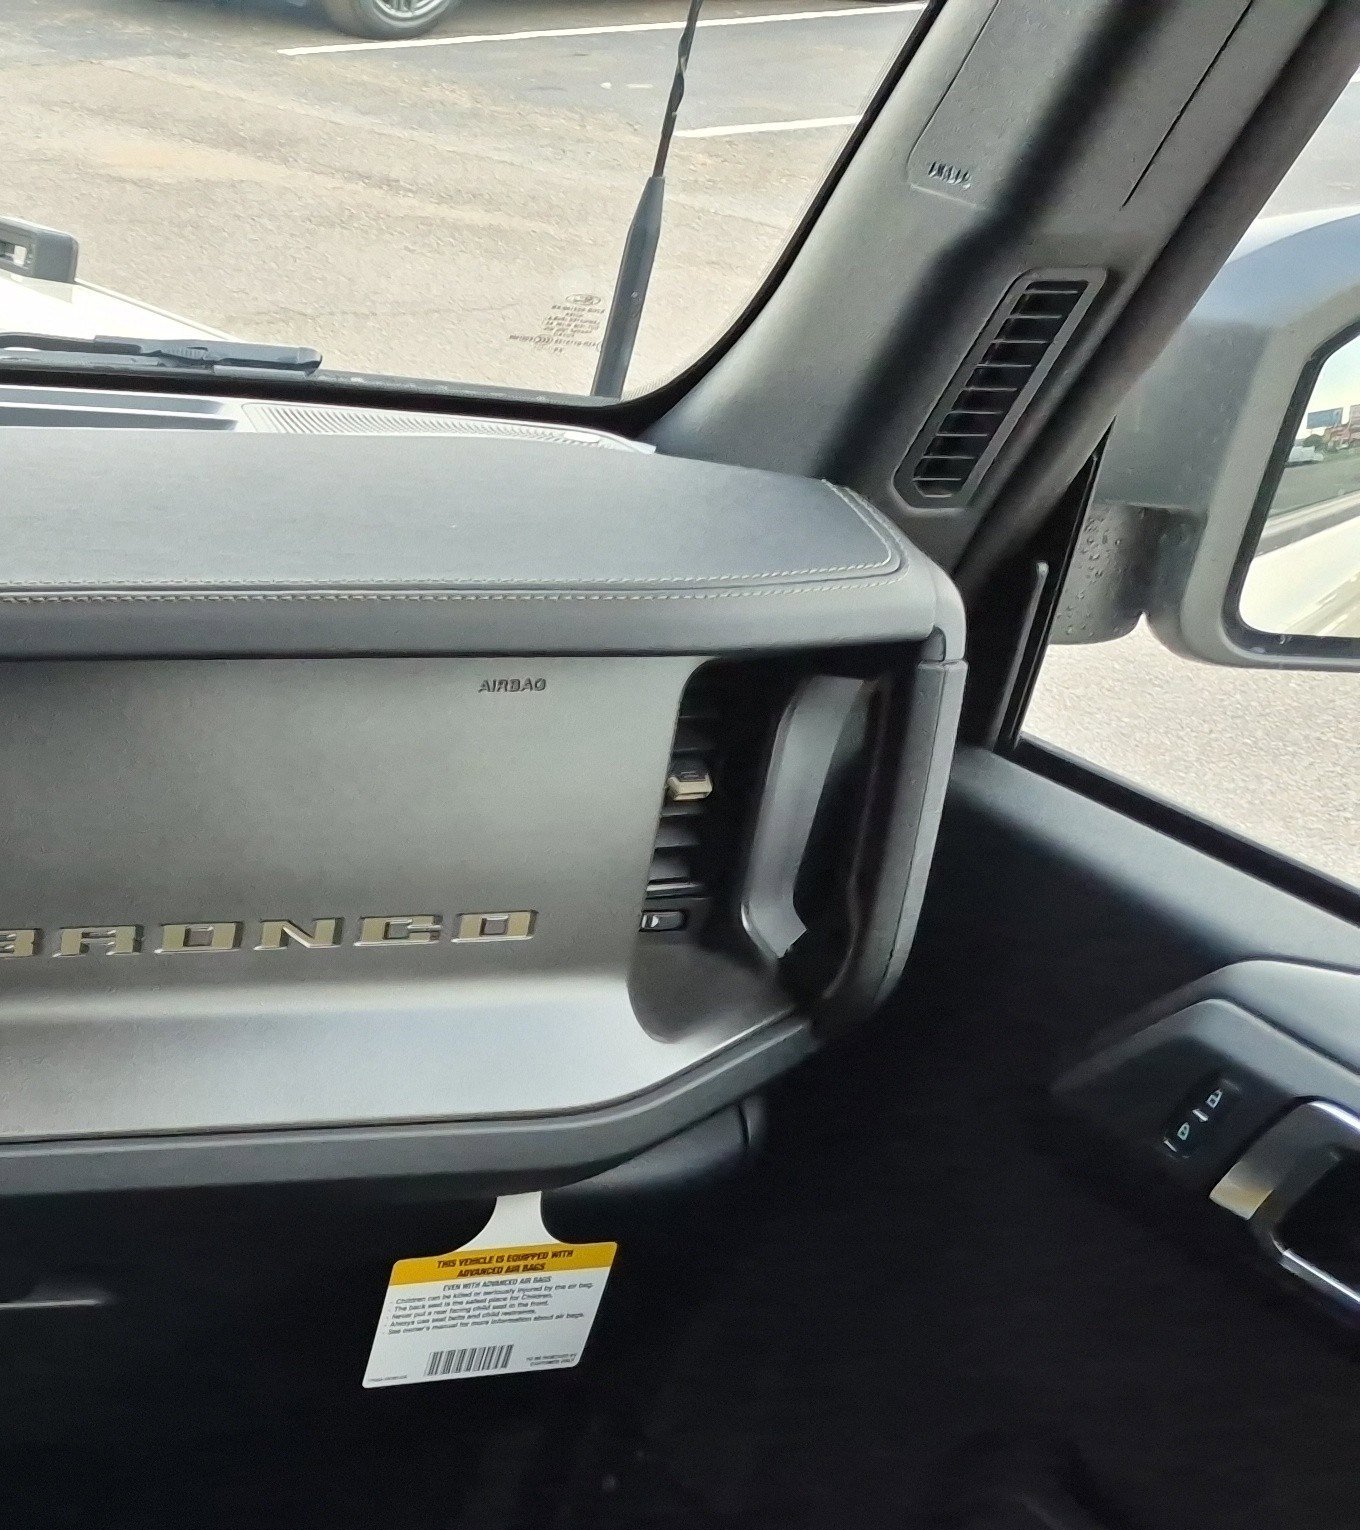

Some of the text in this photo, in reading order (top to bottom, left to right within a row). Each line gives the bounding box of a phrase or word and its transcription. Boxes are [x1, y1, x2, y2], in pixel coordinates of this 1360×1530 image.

[436, 1249, 573, 1268] THIS VEHICLE IS EQUIPPED WITH
[456, 1262, 545, 1277] ADVANCED AIR BAGS
[442, 1283, 461, 1291] EVEN
[461, 1281, 480, 1289] WITH
[481, 1278, 518, 1288] ADVANCED
[532, 1275, 551, 1283] BAGS
